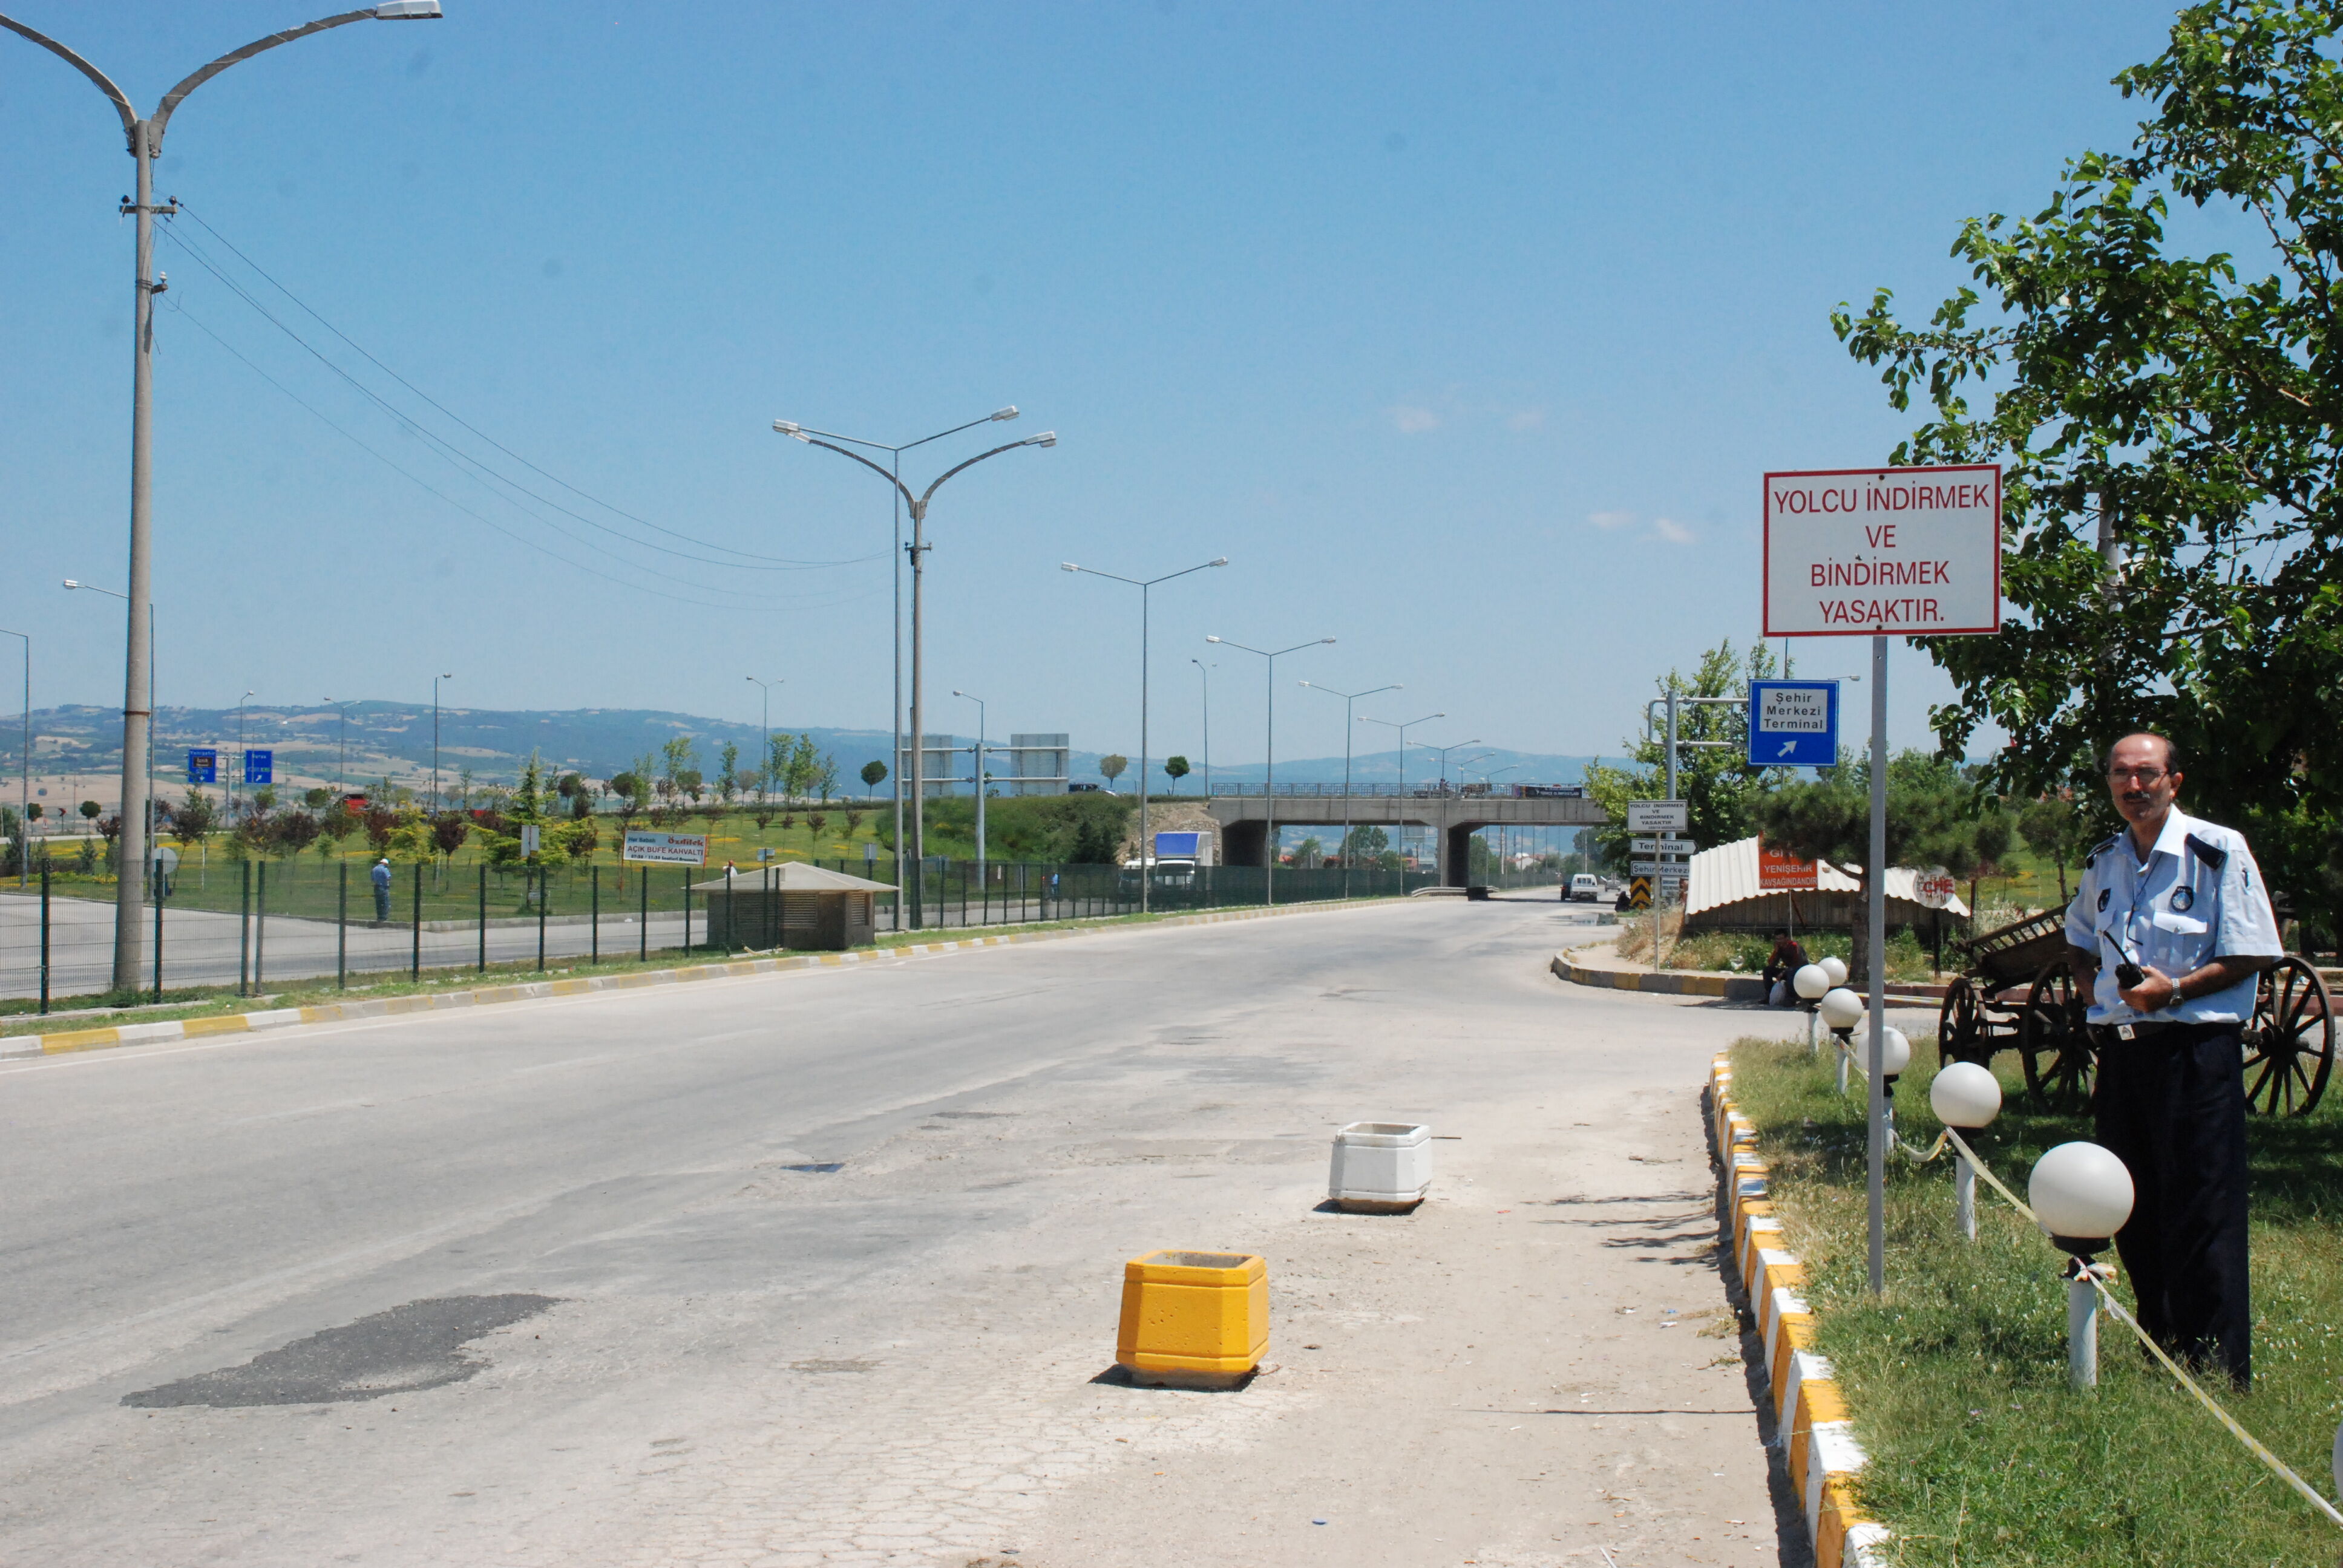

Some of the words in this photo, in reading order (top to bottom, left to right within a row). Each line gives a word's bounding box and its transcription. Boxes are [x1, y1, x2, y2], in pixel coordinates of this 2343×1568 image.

[1774, 489, 1856, 513] YOLCU
[1867, 481, 1990, 511] İNDİRMEK
[1865, 525, 1896, 548] VE
[1811, 556, 1950, 587] BİNDİRMEK
[1819, 599, 1945, 624] YASAKTIR.
[1775, 693, 1812, 705] Şehir
[1767, 705, 1821, 716] Merkezi
[1764, 719, 1823, 729] Terminal
[667, 836, 704, 846] Özdilek
[668, 847, 704, 855] KAHVALTI
